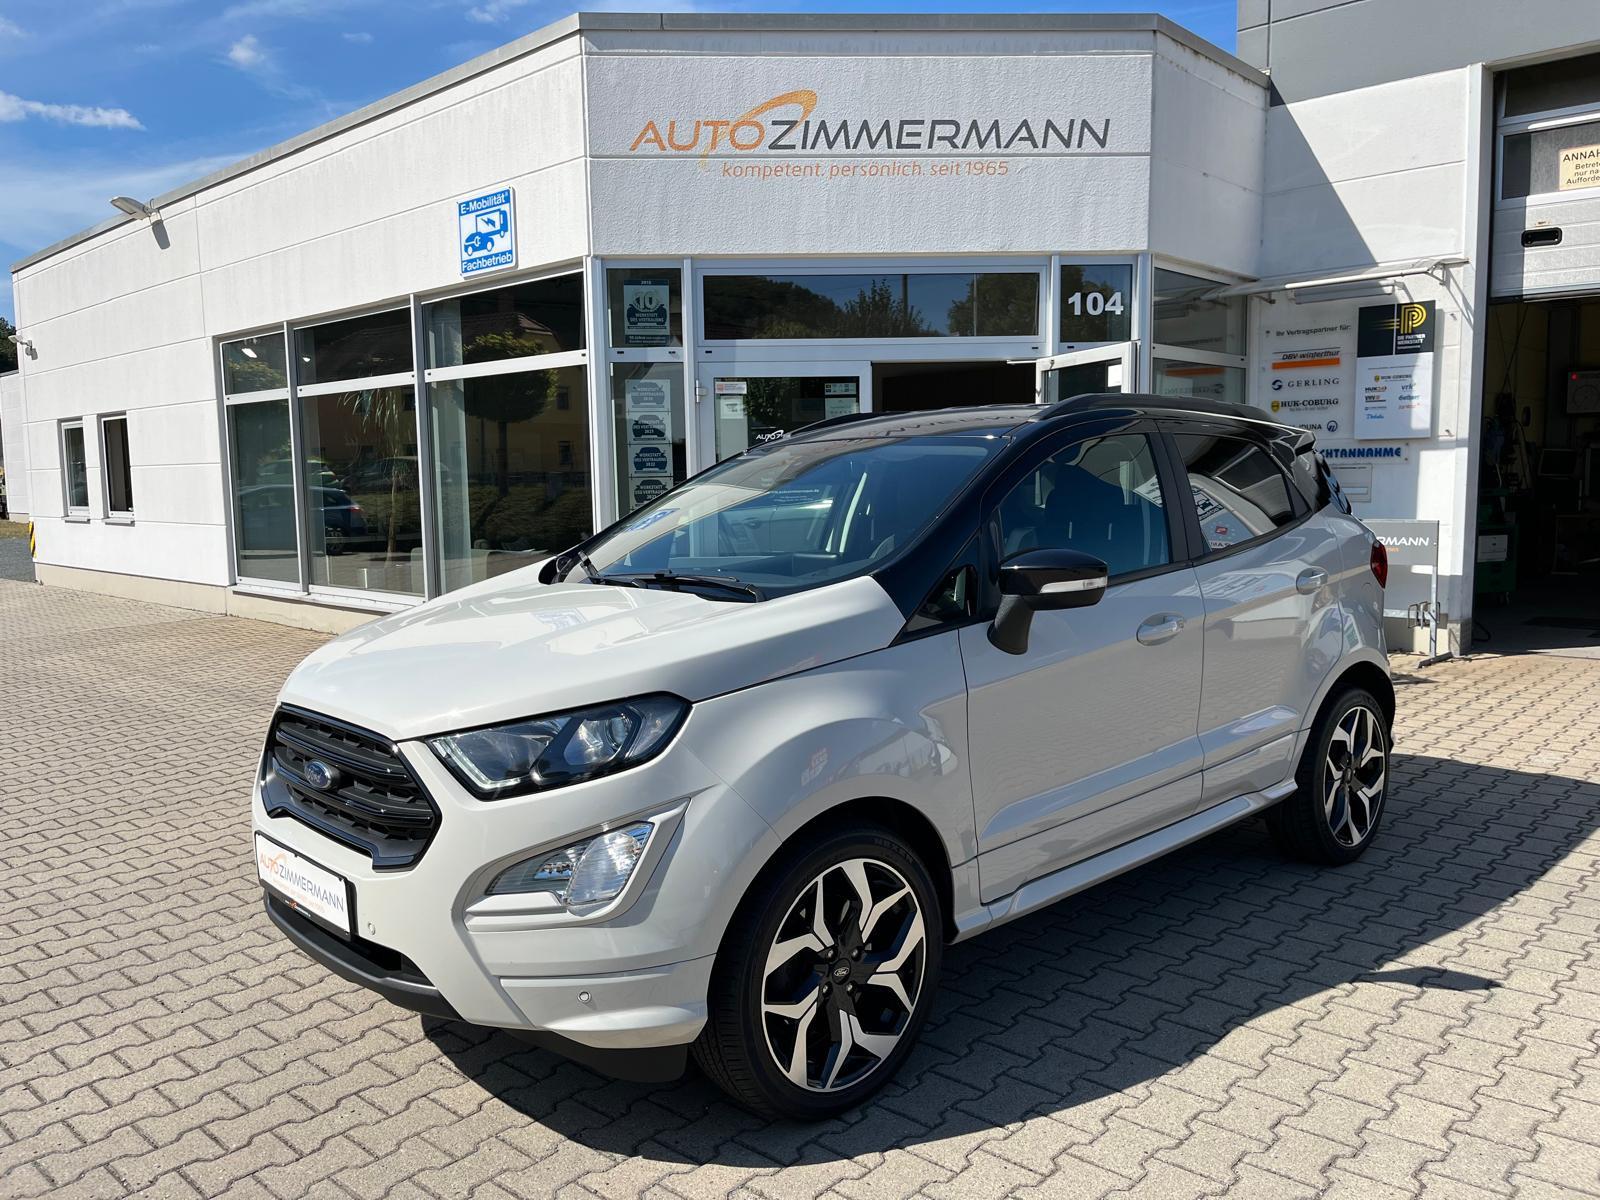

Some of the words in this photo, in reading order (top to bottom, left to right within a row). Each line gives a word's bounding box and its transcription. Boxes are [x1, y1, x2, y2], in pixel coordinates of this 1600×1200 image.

[722, 161, 826, 180] kompetent.
[828, 161, 926, 179] persönlich.
[929, 161, 961, 177] seit
[965, 161, 1009, 177] 1965
[1575, 161, 1600, 170] Betret
[462, 252, 513, 272] Fachbetrieb
[1067, 291, 1124, 316] 104
[1286, 326, 1338, 336] Vertragspartner
[1287, 378, 1340, 388] GERLING
[1281, 398, 1339, 408] HUK-COBURG
